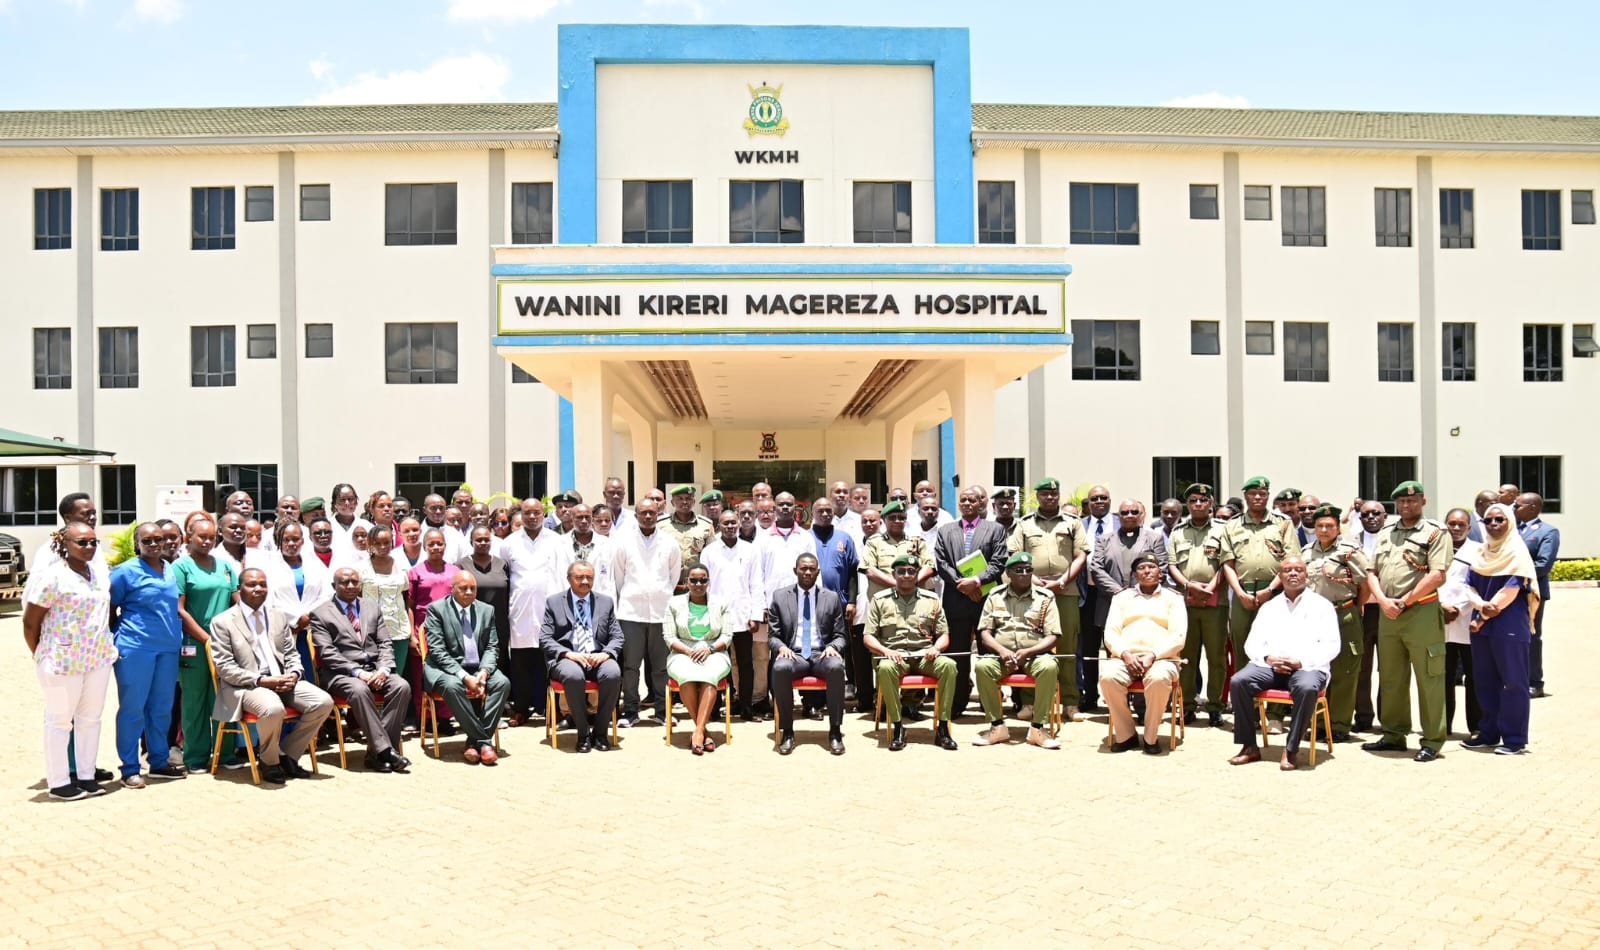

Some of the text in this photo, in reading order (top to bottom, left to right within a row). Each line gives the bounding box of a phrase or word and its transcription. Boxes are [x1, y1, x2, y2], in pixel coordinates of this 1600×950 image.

[735, 150, 799, 164] WKMH
[515, 294, 1048, 317] WANINI KIRERI MAGEREZA HOSPITAL
